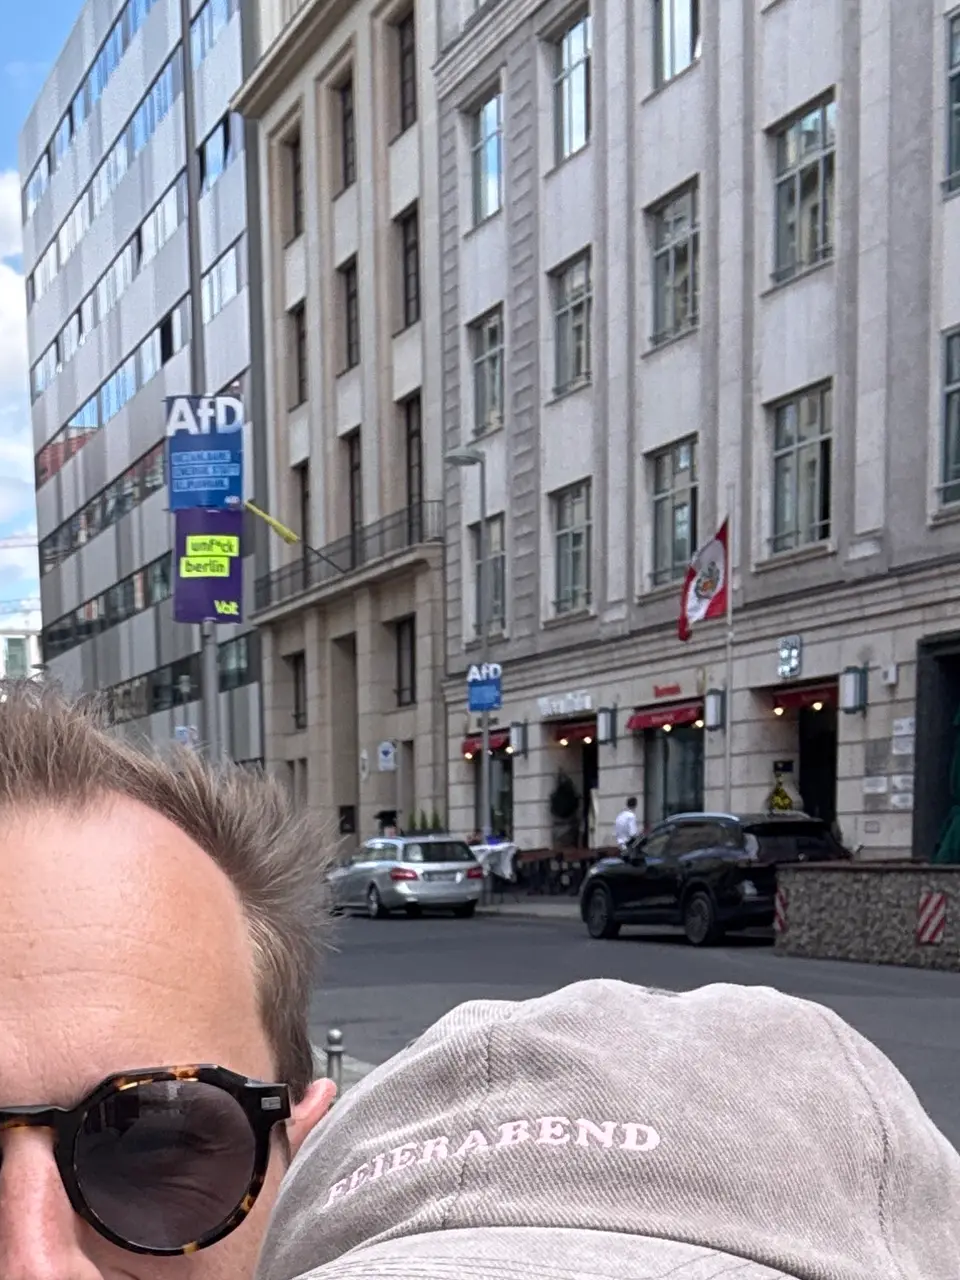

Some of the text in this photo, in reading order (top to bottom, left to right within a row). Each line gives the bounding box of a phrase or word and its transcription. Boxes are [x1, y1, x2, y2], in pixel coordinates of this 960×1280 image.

[166, 396, 244, 436] AfD
[185, 558, 225, 573] berlin
[467, 662, 502, 682] AfD
[322, 1115, 661, 1210] FEIERABEND
